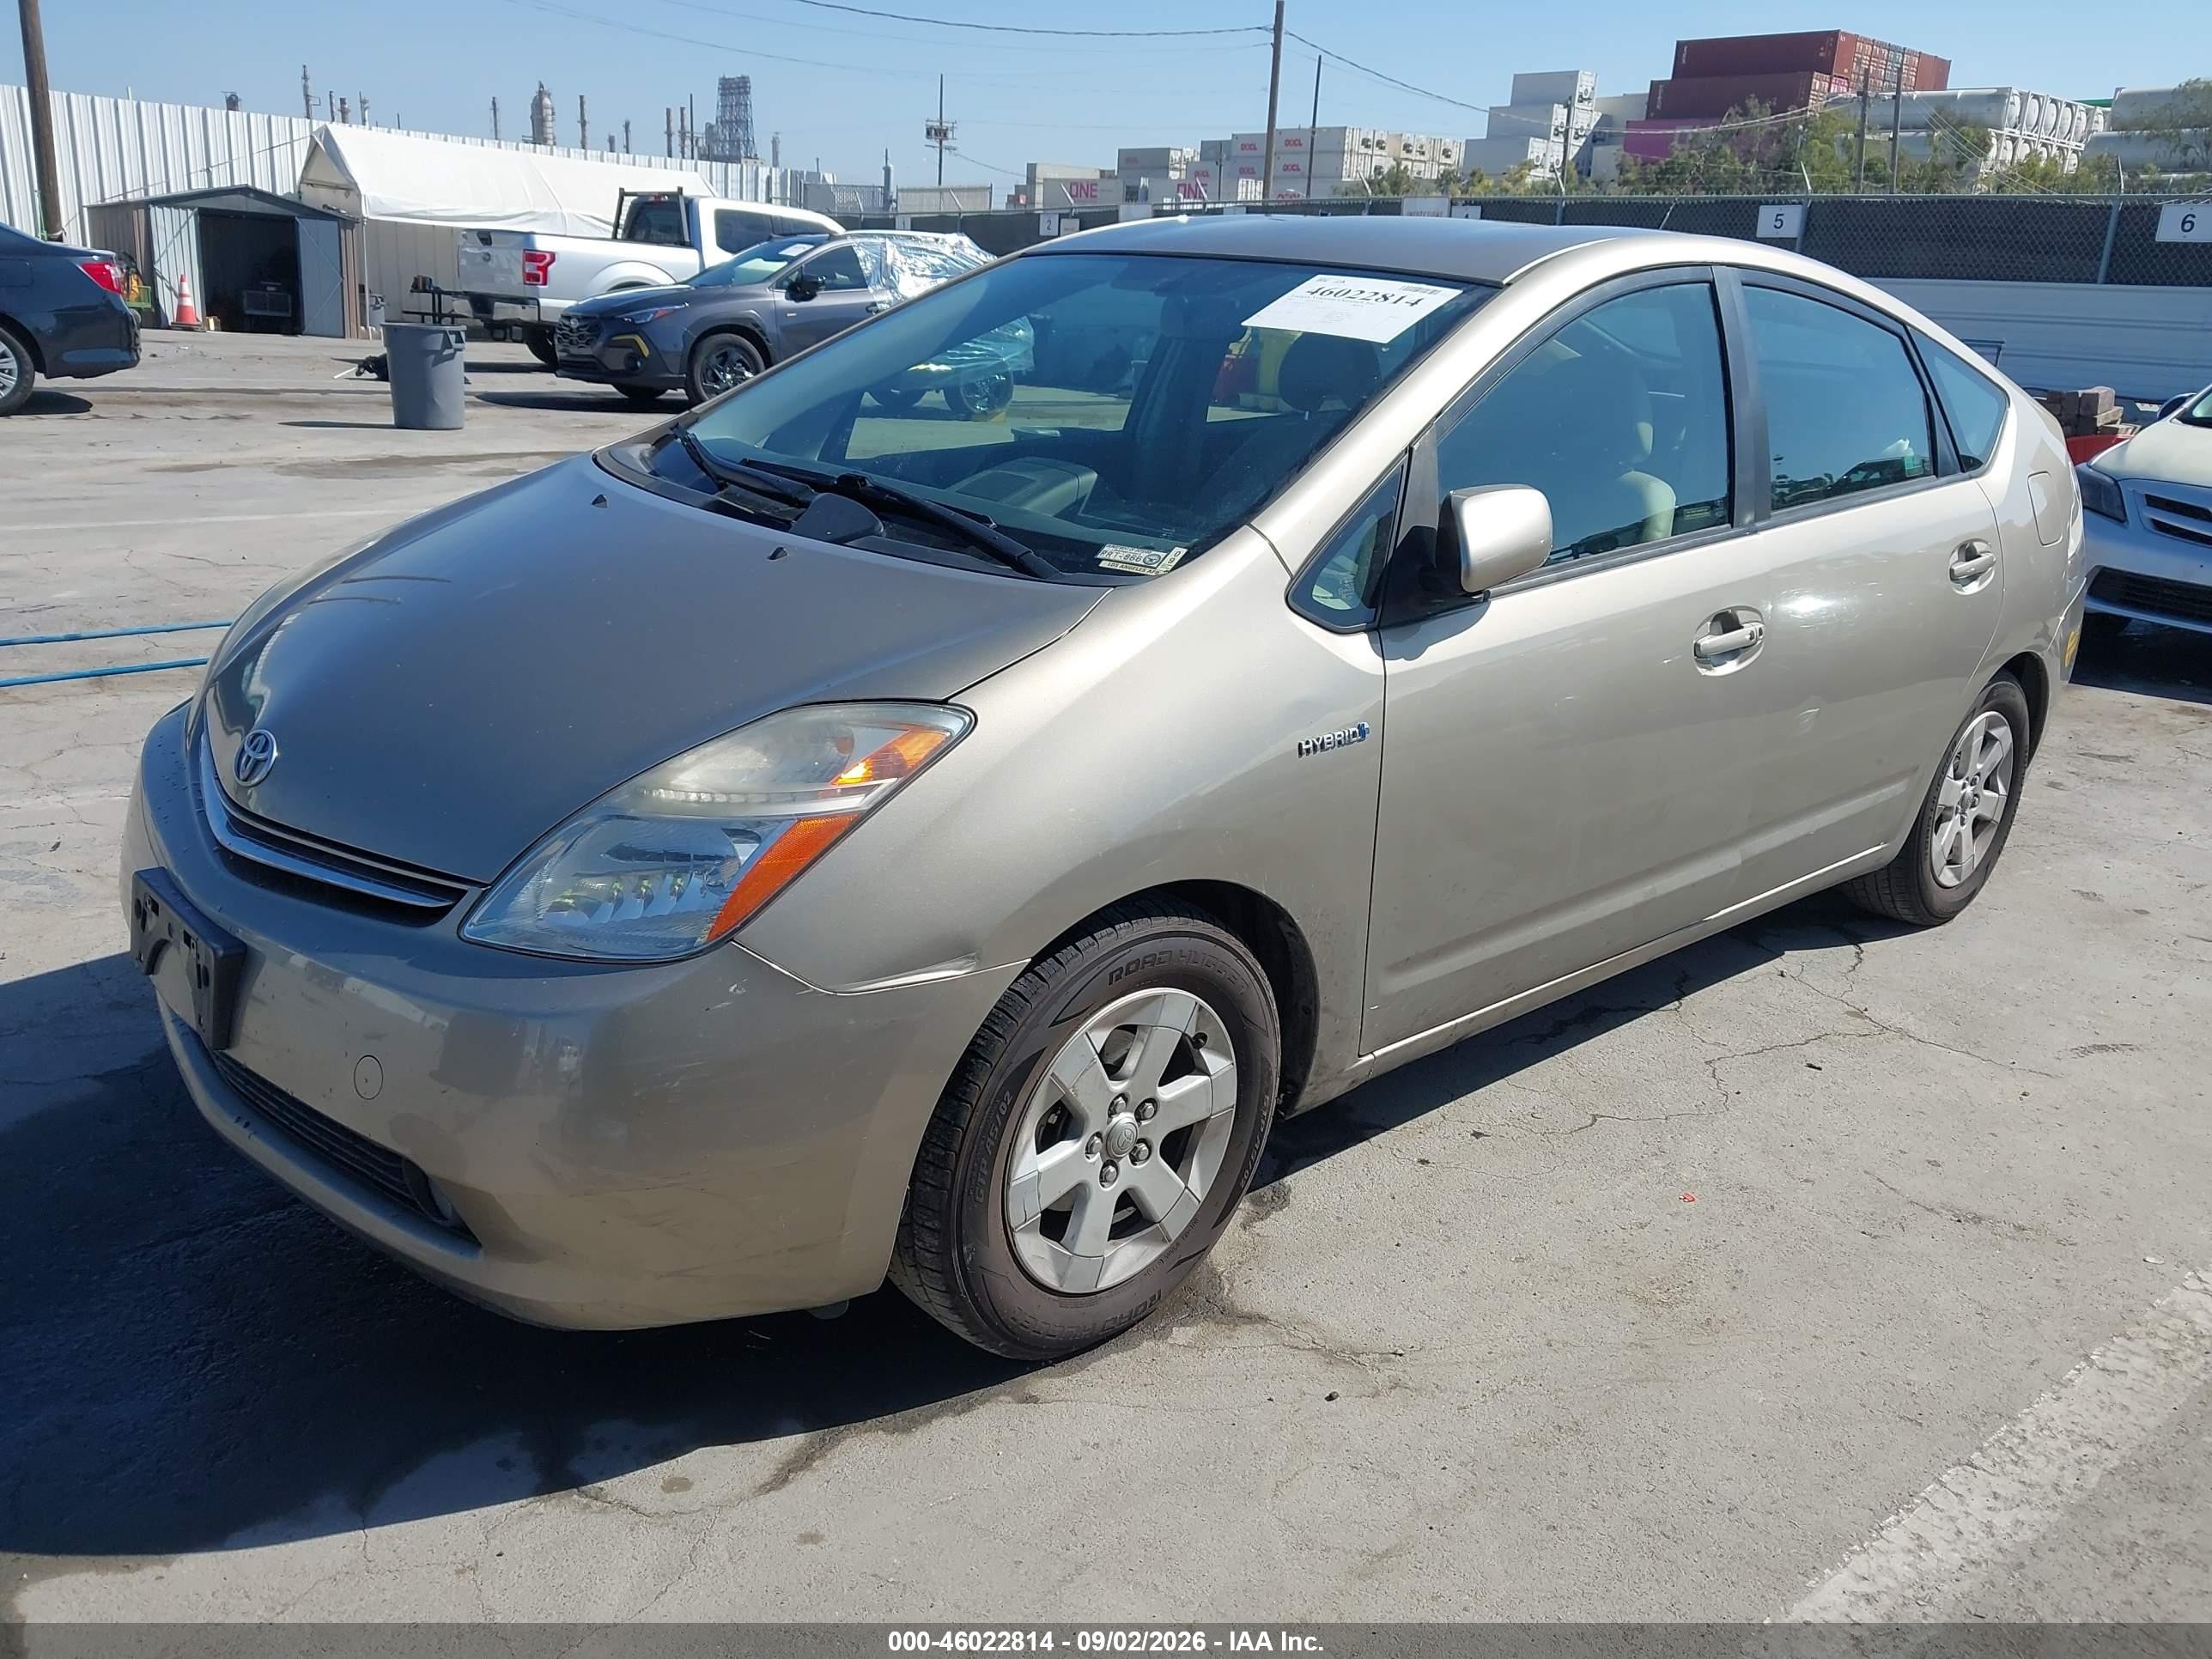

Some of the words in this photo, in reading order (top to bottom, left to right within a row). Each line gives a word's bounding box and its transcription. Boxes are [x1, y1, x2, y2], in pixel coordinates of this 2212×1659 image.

[1070, 182, 1098, 198] ONE
[1046, 219, 1052, 231] 2
[1773, 213, 1784, 229] 5
[2180, 213, 2197, 232] 6
[1306, 286, 1424, 307] 46022814
[1119, 563, 1147, 573] ANGELES
[1297, 728, 1360, 758] HYBRID
[1108, 950, 1173, 986] ROAD
